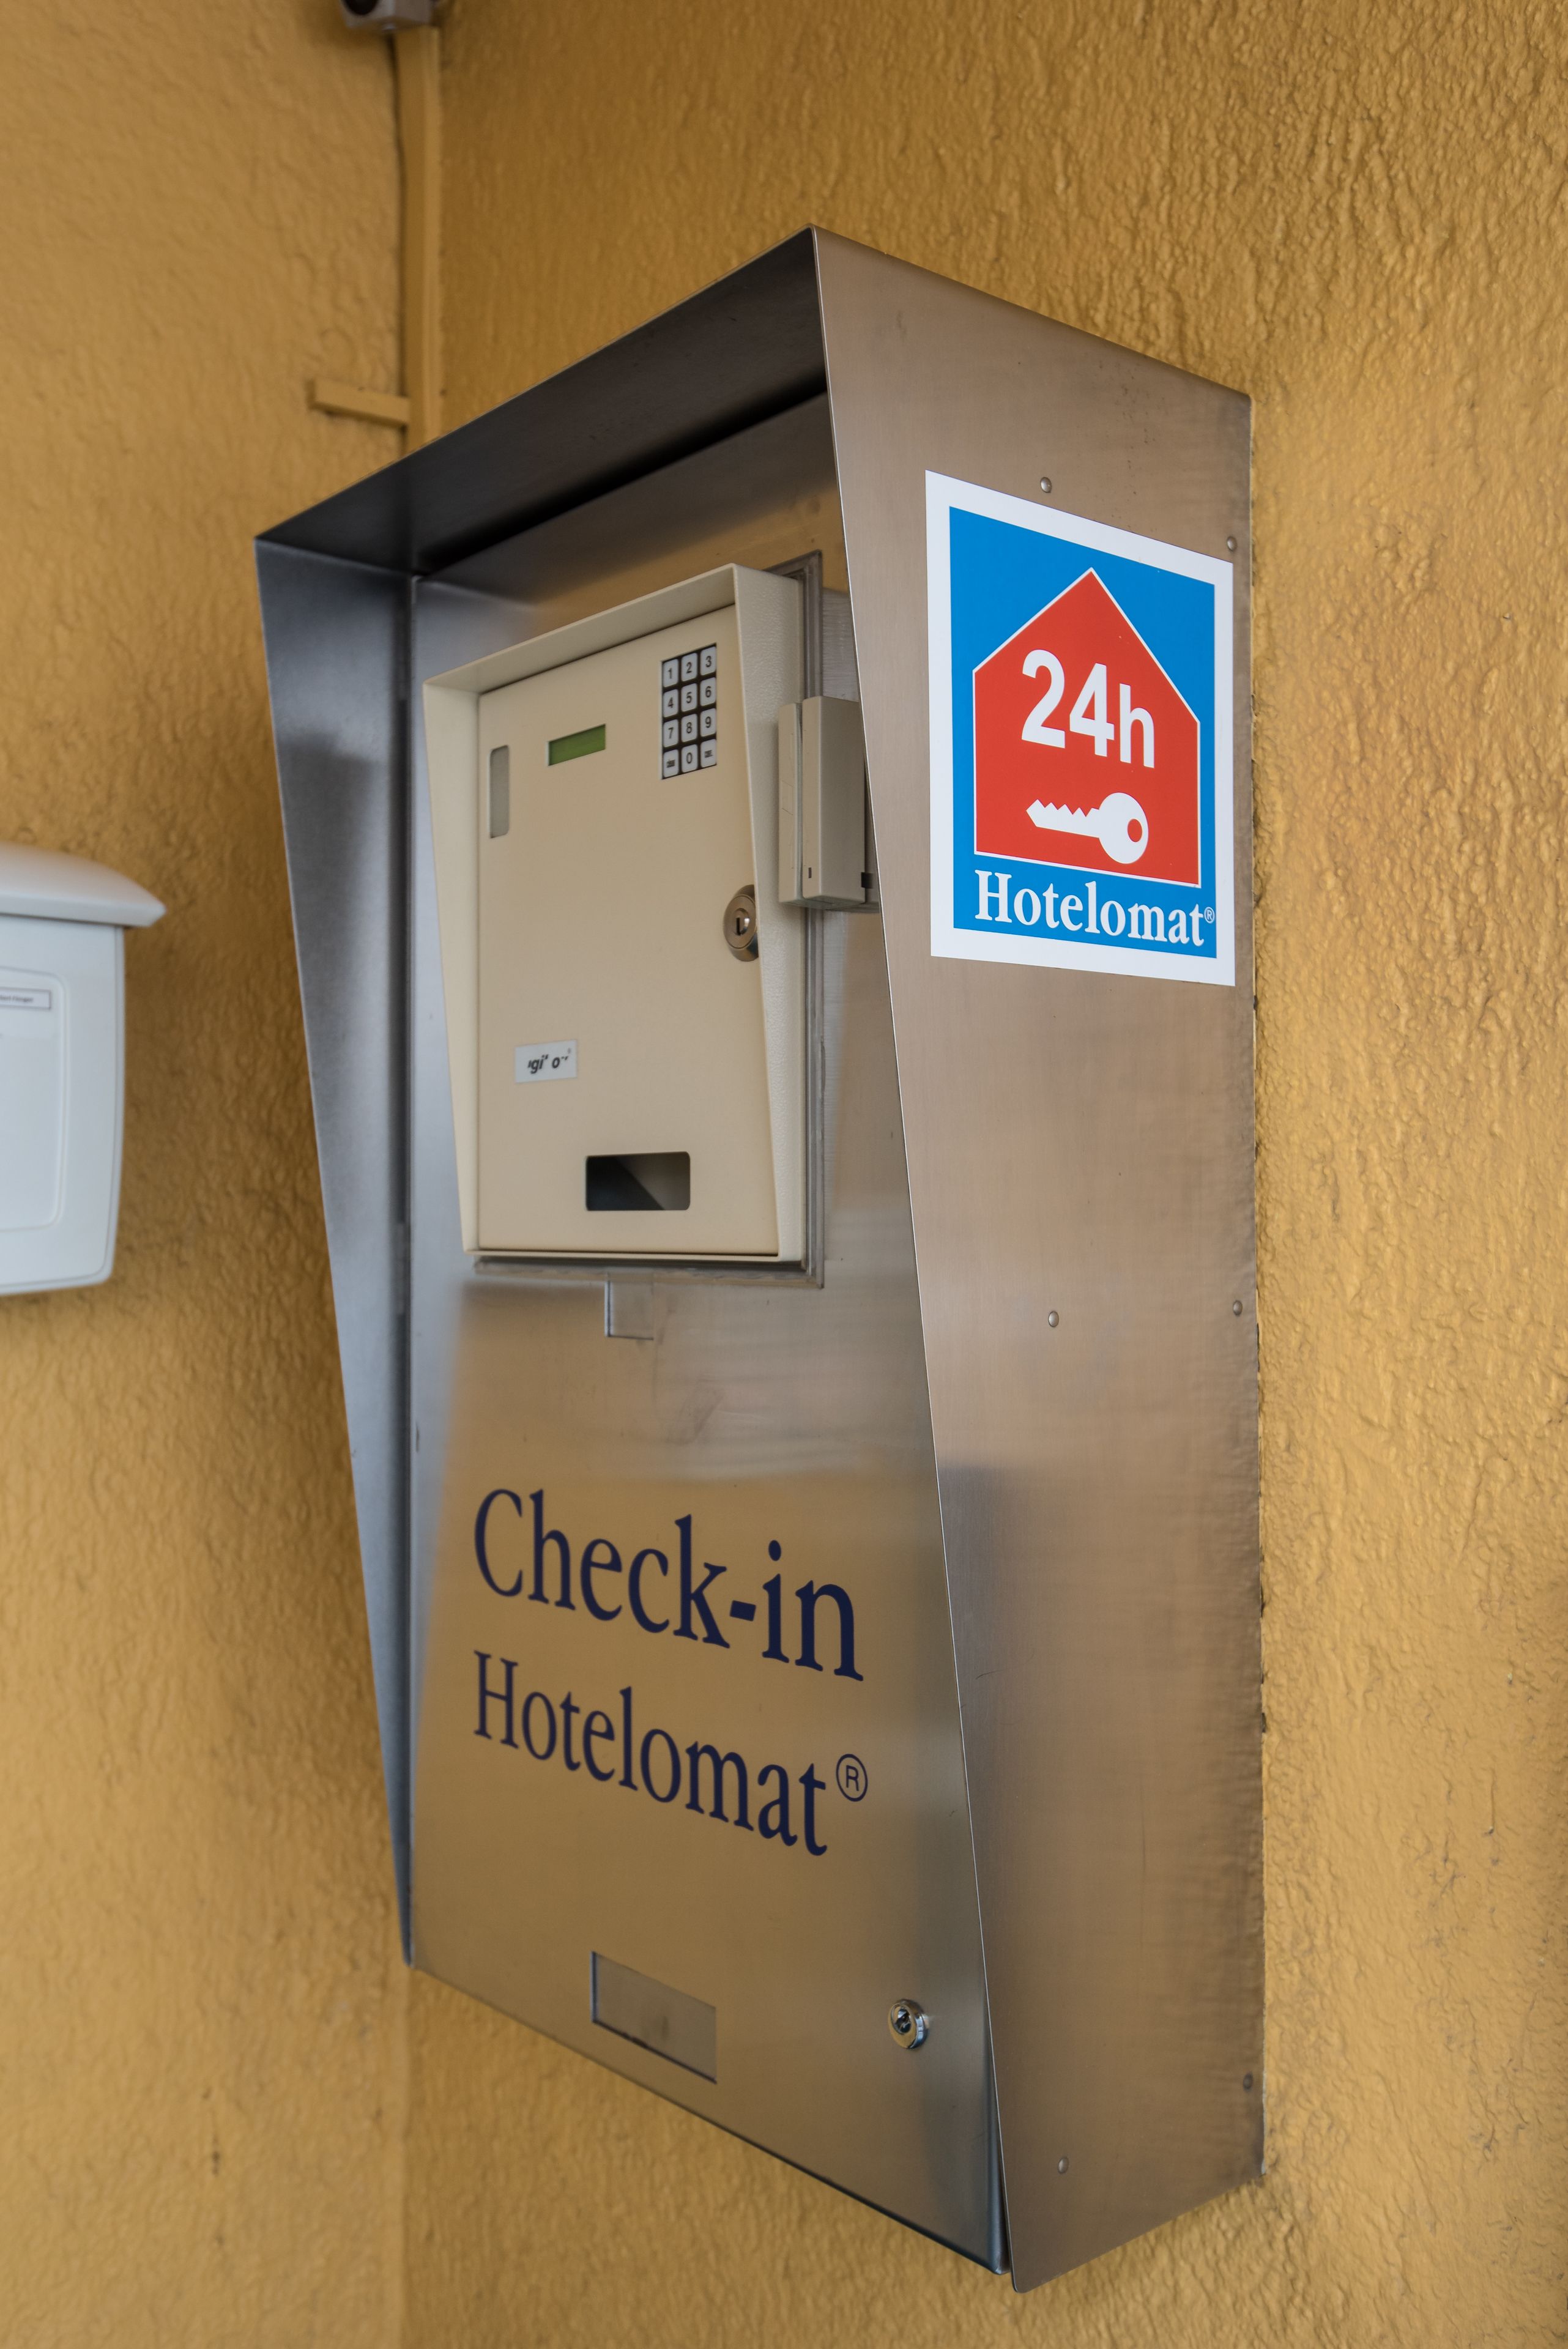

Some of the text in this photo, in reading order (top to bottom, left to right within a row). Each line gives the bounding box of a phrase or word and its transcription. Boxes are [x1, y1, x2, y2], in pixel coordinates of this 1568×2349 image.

[667, 655, 712, 679] 1 2 3
[667, 685, 712, 708] 4 5 6
[1021, 649, 1155, 769] 24h
[668, 716, 712, 739] 7 8 9
[686, 752, 693, 764] 0
[474, 1488, 864, 1682] Check-in
